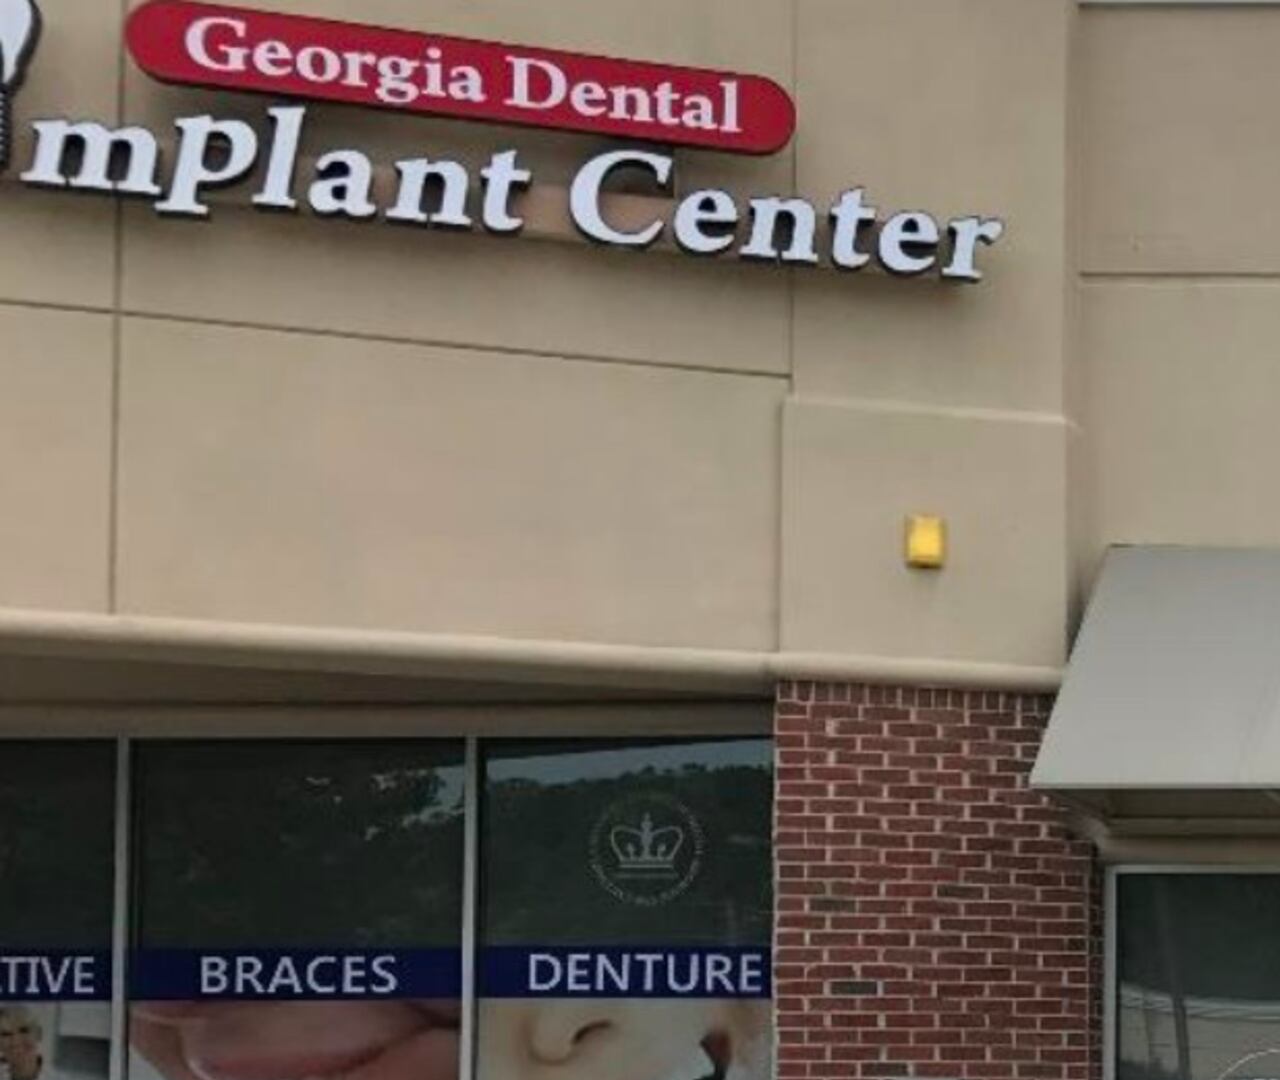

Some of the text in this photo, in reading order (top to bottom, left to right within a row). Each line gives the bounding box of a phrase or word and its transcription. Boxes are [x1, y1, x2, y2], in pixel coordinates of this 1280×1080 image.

[183, 16, 742, 135] Georgia Dental
[567, 149, 1004, 284] Center
[0, 956, 95, 993] TIVE
[200, 955, 399, 993] BRACES
[527, 954, 763, 993] DENTURE
